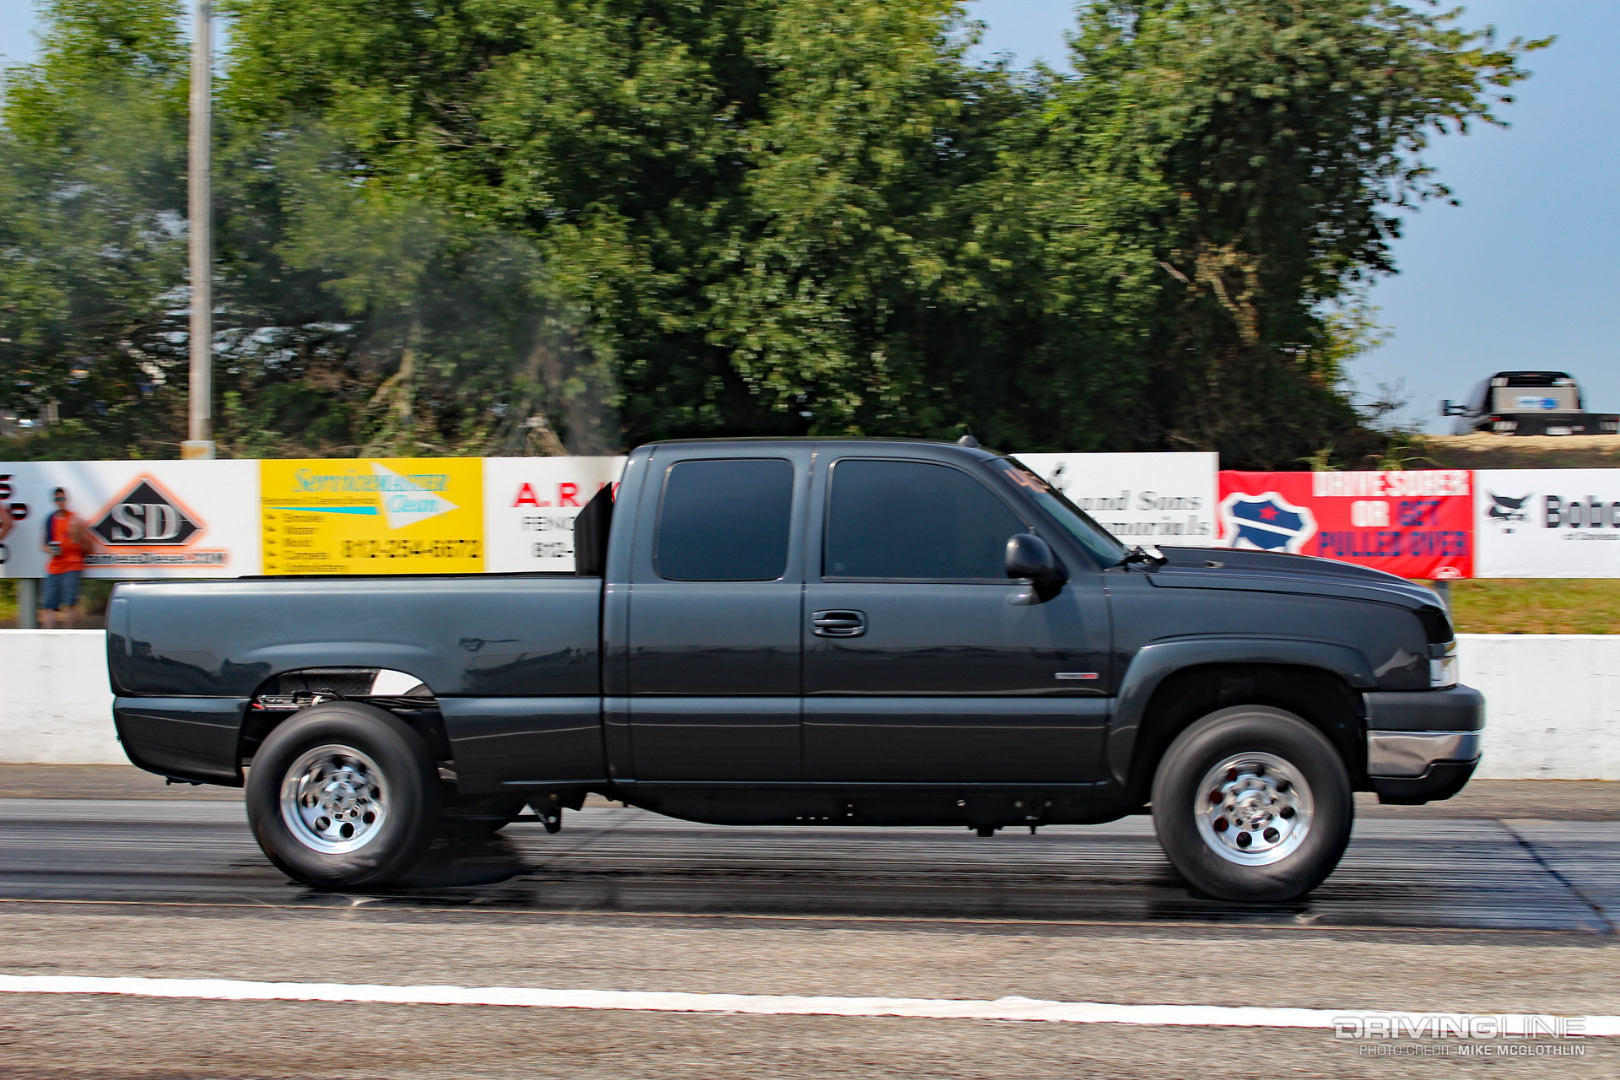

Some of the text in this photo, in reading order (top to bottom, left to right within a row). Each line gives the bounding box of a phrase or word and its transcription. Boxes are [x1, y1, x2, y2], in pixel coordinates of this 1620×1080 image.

[1313, 470, 1469, 496] DRIVE SOBER
[387, 494, 439, 513] Clean
[1078, 489, 1203, 511] and Sons
[111, 503, 182, 541] SD
[1351, 500, 1442, 527] OR GET
[1317, 531, 1467, 556] PULLED OVER
